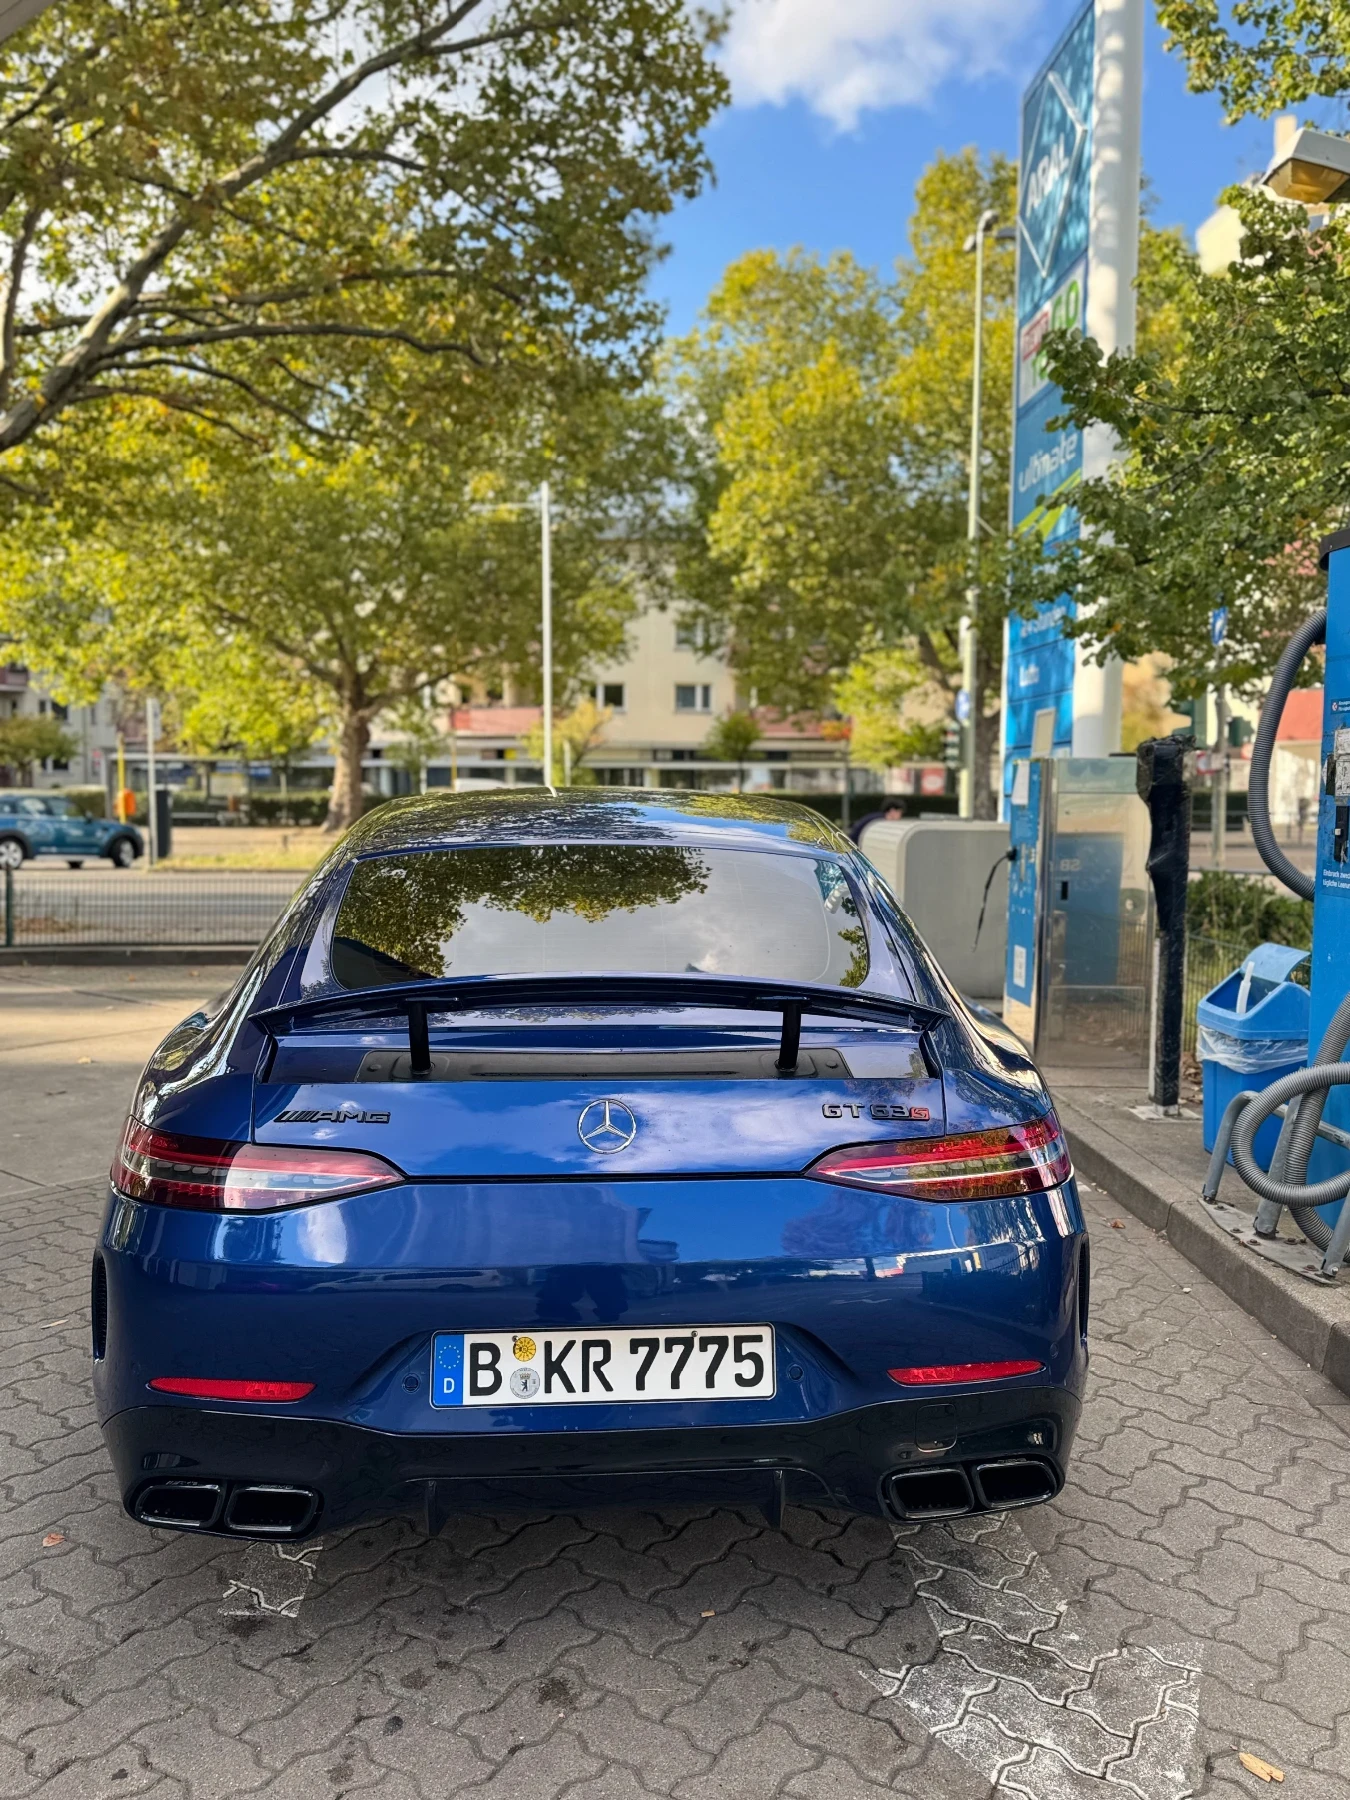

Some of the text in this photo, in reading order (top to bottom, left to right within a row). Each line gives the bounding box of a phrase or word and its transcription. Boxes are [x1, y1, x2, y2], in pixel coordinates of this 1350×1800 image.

[1025, 131, 1070, 219] ARAL
[1018, 432, 1078, 493] ultimate
[822, 1103, 865, 1118] GT
[443, 1377, 455, 1394] D
[469, 1342, 503, 1397] B
[544, 1339, 614, 1394] KR
[629, 1334, 765, 1391] 7775
